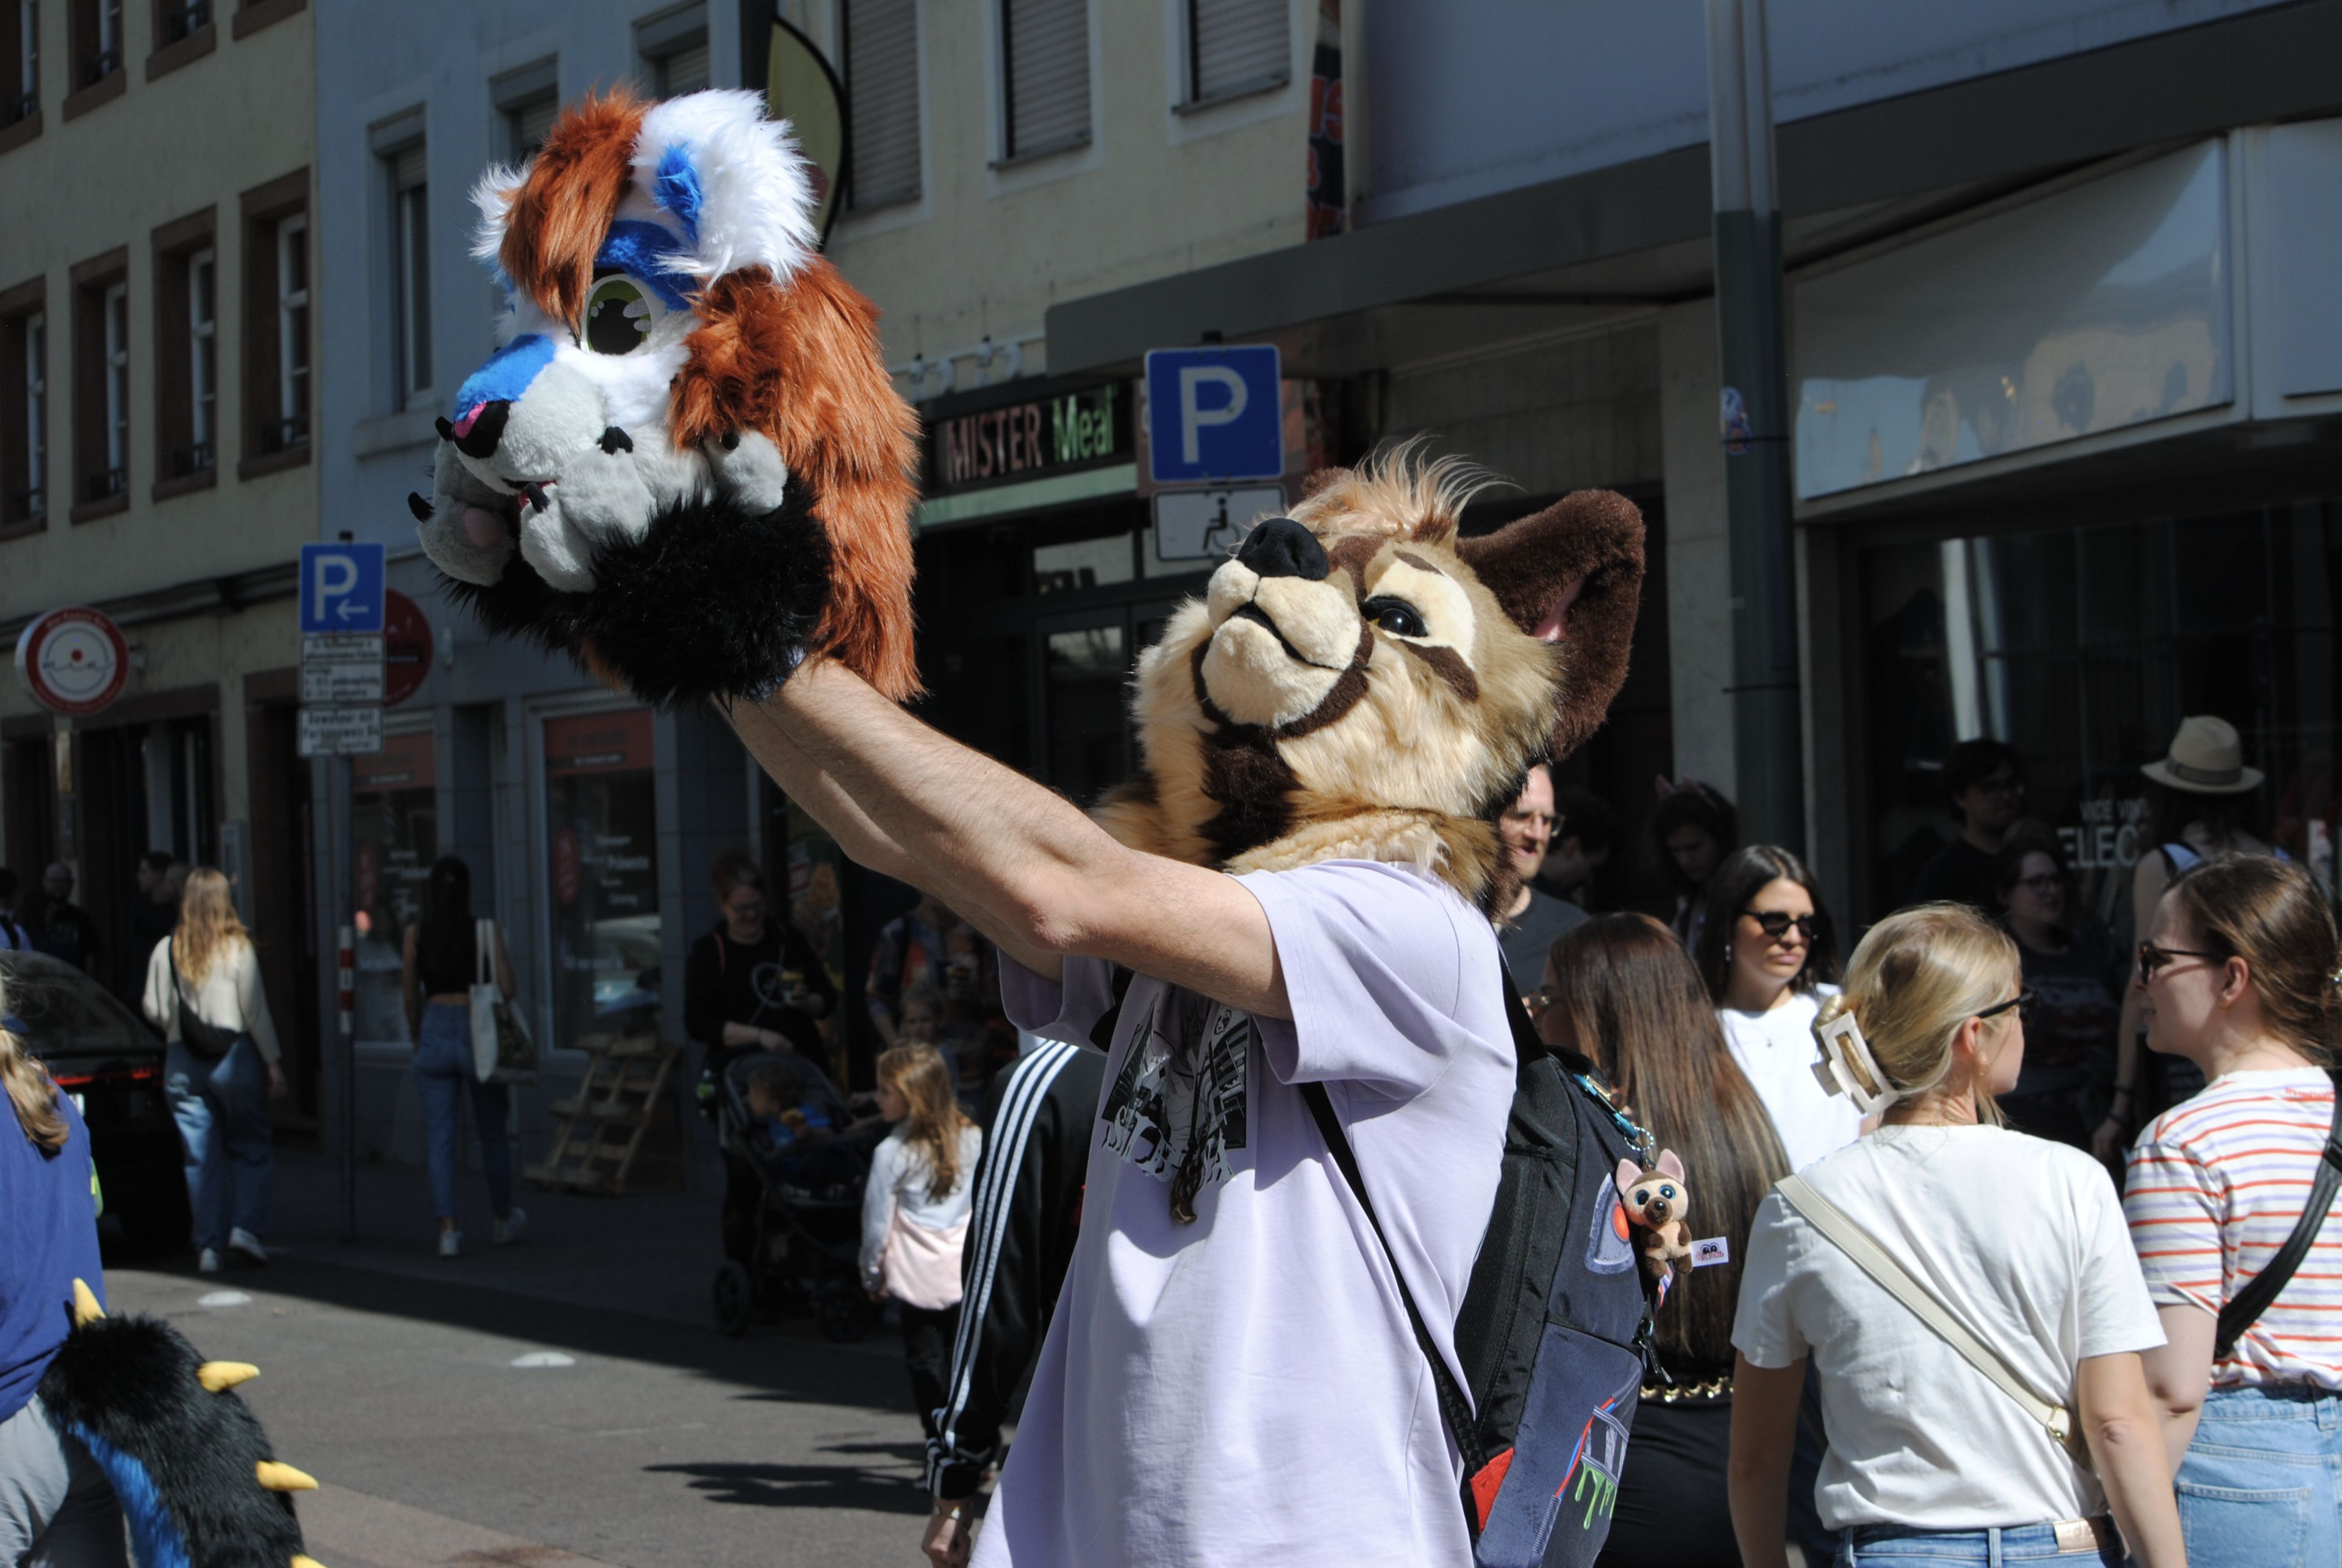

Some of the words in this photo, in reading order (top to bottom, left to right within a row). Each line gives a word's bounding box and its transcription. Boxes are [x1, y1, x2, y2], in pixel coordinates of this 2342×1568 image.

[947, 403, 1044, 483] MISTER
[1052, 384, 1115, 464] Meal
[1180, 366, 1248, 465] P
[313, 554, 359, 622] P
